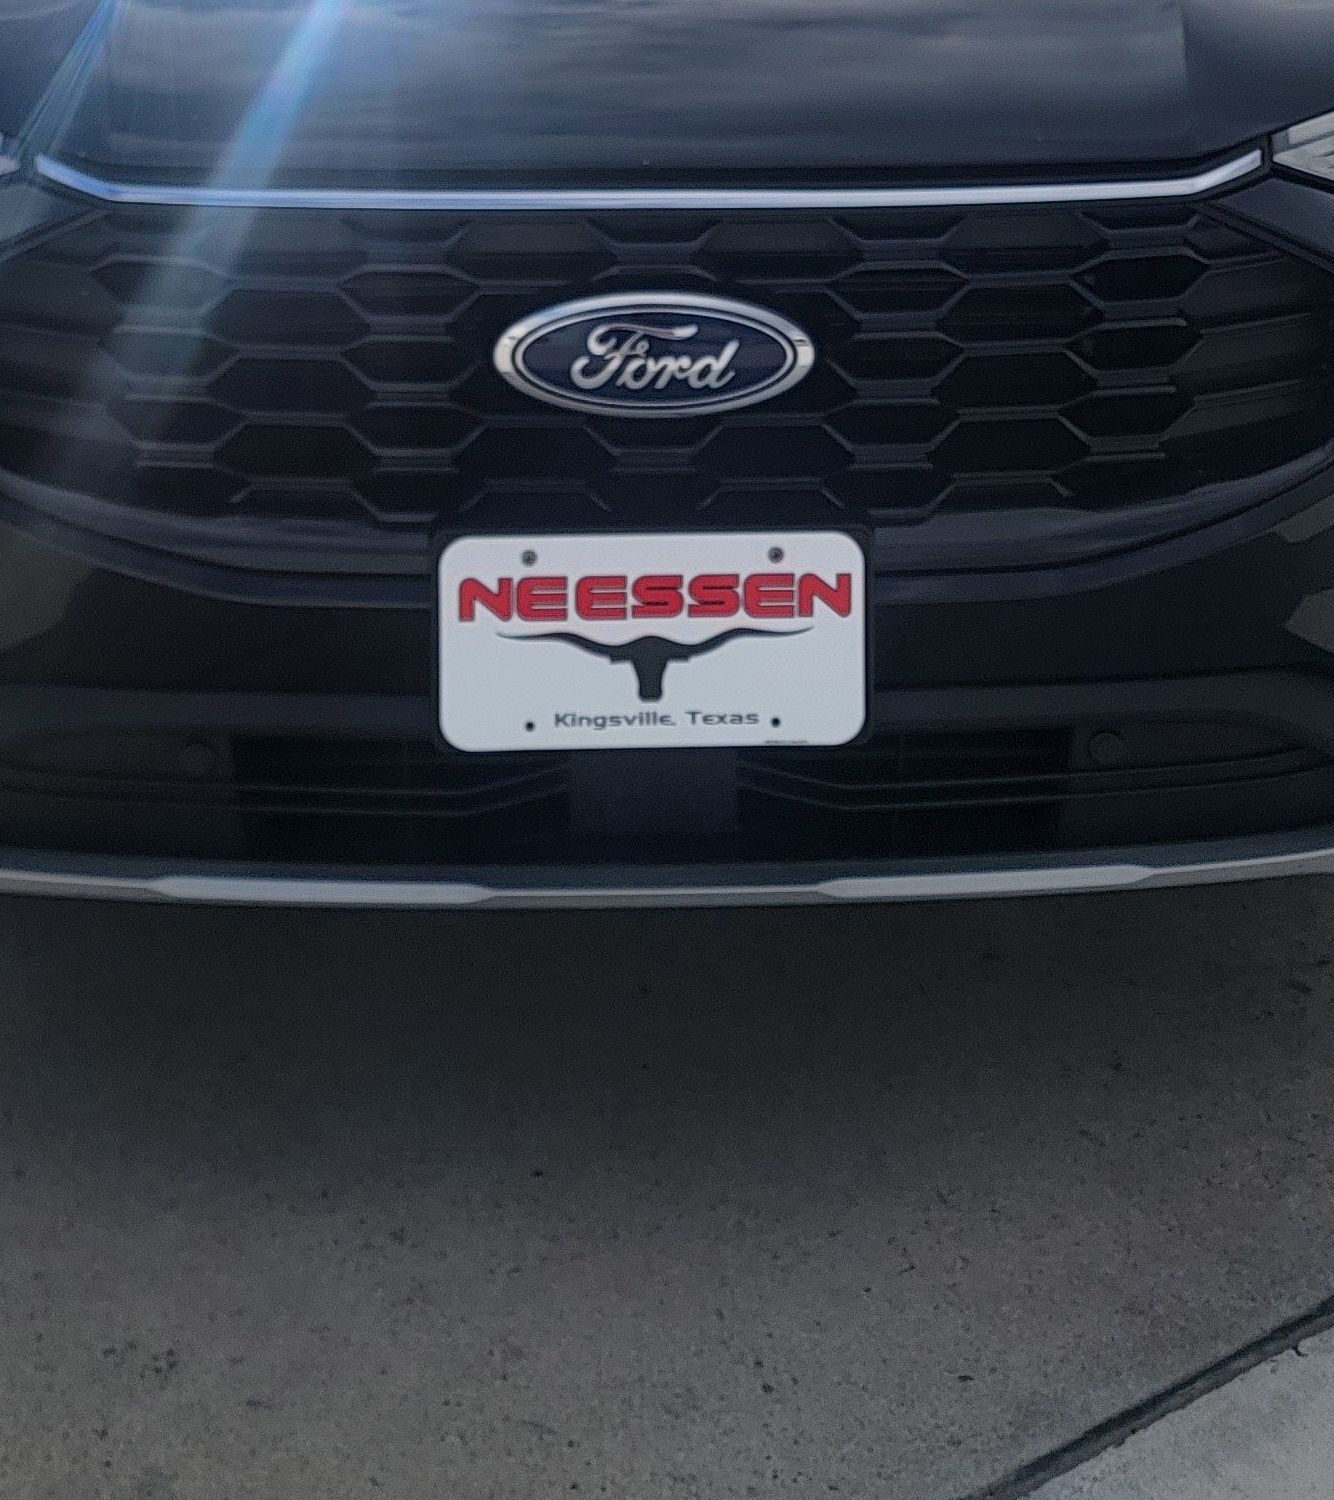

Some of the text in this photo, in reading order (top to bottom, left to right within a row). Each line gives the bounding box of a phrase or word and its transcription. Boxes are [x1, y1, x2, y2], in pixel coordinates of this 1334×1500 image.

[571, 322, 740, 390] Ford
[458, 573, 852, 622] NEESSEN
[685, 710, 760, 726] Texas
